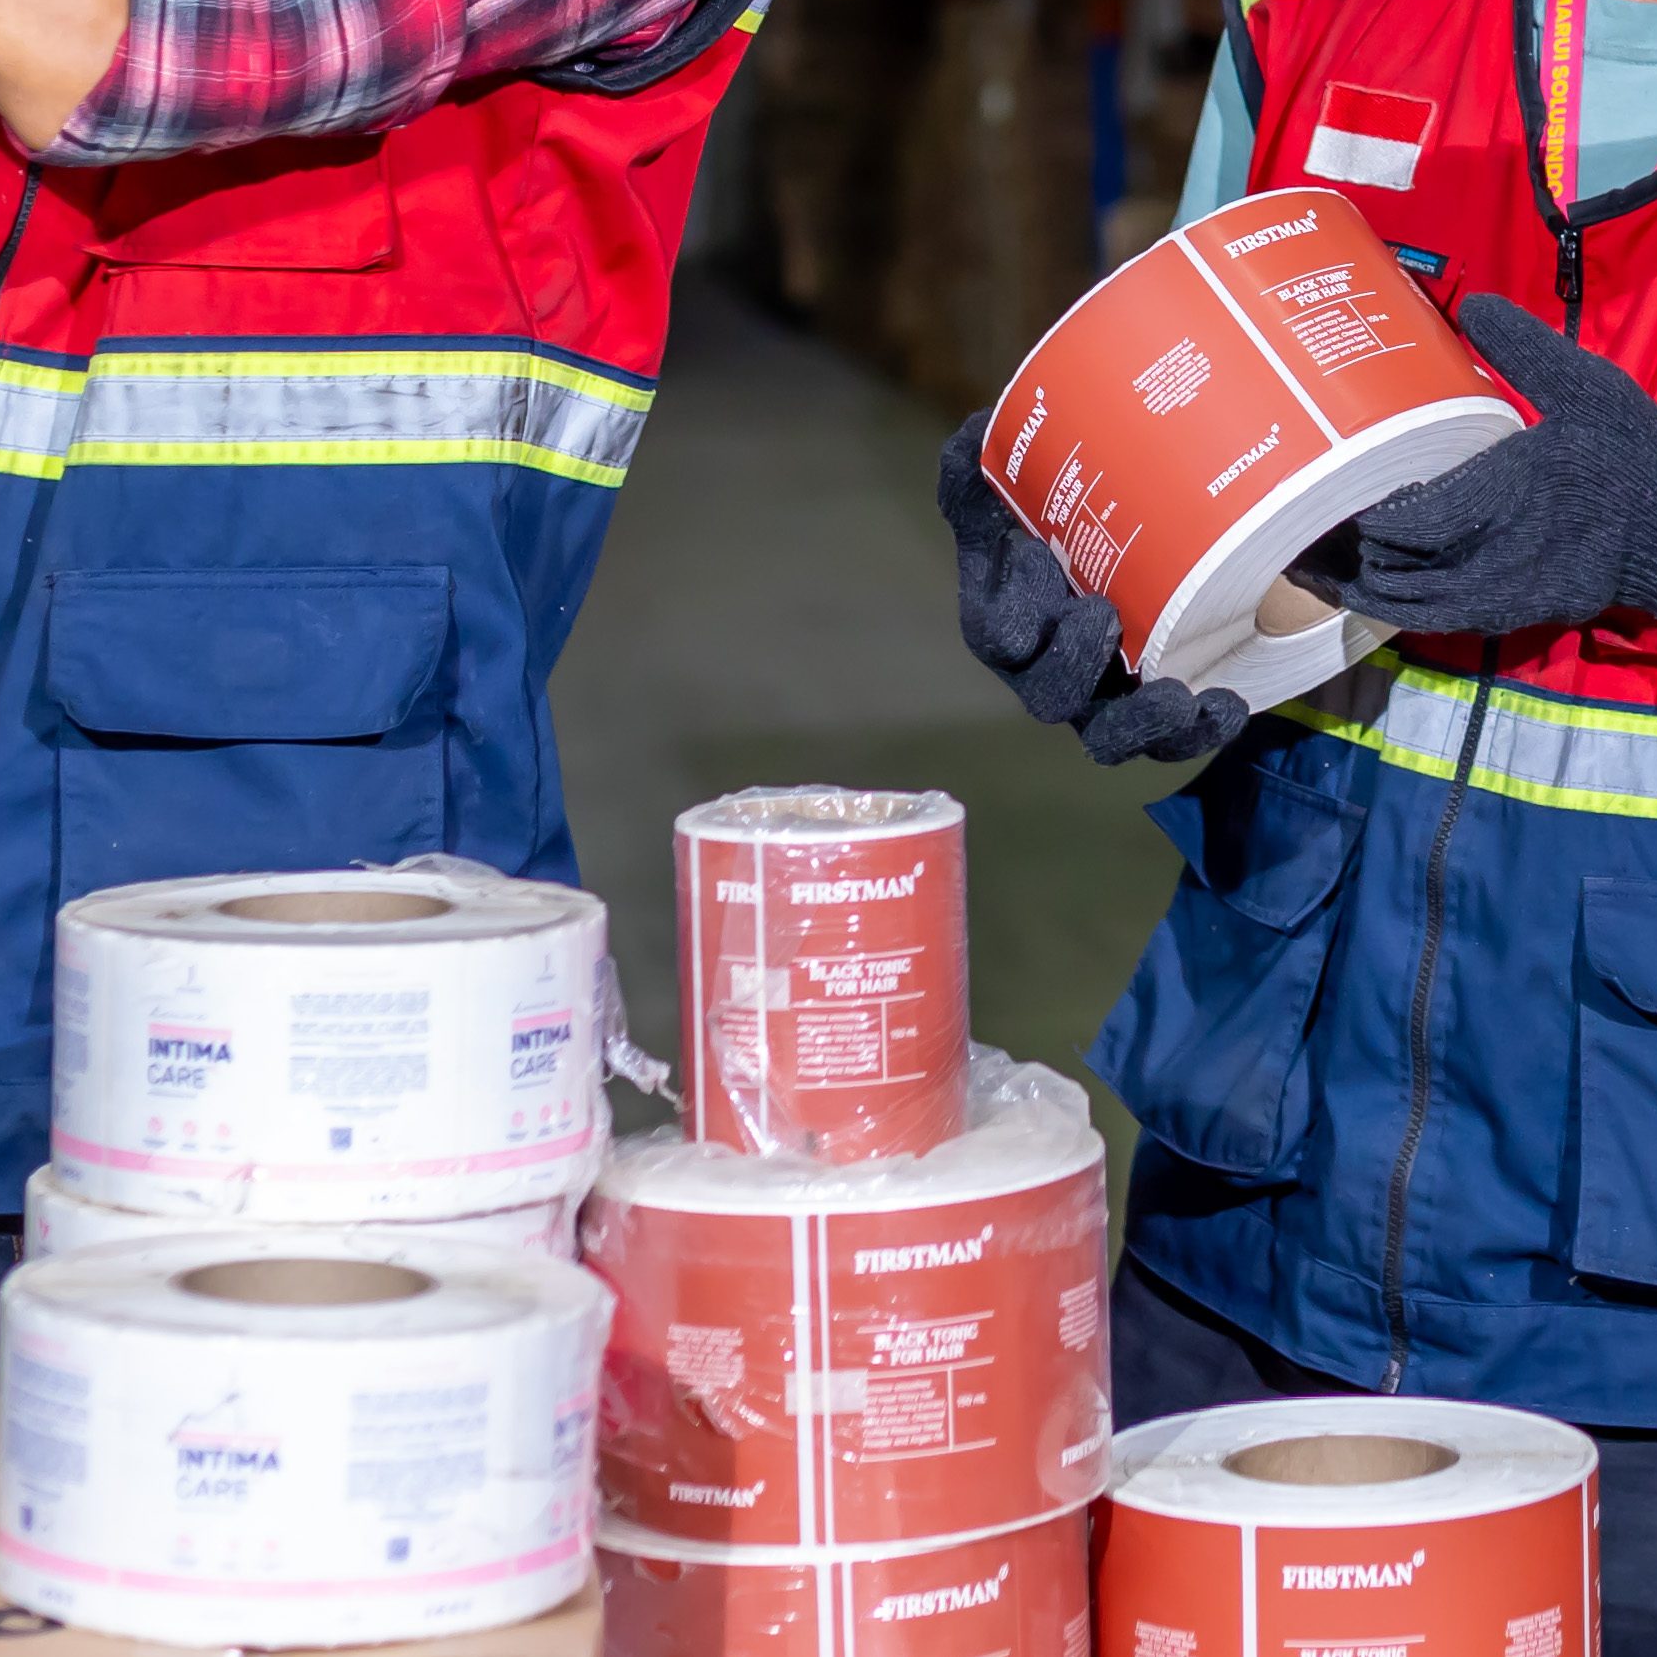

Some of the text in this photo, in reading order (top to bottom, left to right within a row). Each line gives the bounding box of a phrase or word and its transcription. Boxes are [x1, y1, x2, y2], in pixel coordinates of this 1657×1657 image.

[1544, 64, 1571, 199] SOLUSINDO
[1223, 216, 1319, 259] FIRSTMAN
[1276, 269, 1353, 302] BLACK TONIC
[1295, 282, 1352, 307] FOR HAIR
[1005, 400, 1048, 485] FIRSTMAN
[1206, 433, 1280, 498] FIRSTMAN
[1046, 458, 1083, 526] BLACK TONIC
[1056, 478, 1085, 528] FOR HAIR
[790, 874, 915, 905] FIRSTMAN
[809, 957, 912, 982] BLACK TONIC
[825, 976, 900, 998] FOR HAIR
[147, 1037, 233, 1064] INTIMA
[511, 1023, 571, 1054] INTIMA
[147, 1064, 207, 1090] CARE
[510, 1051, 559, 1081] CARE
[854, 1238, 983, 1275] FIRSTMAN
[874, 1321, 980, 1352] BLACK TONIC
[889, 1342, 965, 1367] FOR HAIR
[176, 1447, 282, 1474] INTIMA
[668, 1481, 756, 1508] FIRSTMAN
[1282, 1560, 1413, 1590] FIRSTMAN
[875, 1575, 1000, 1623] FIRSTMAN
